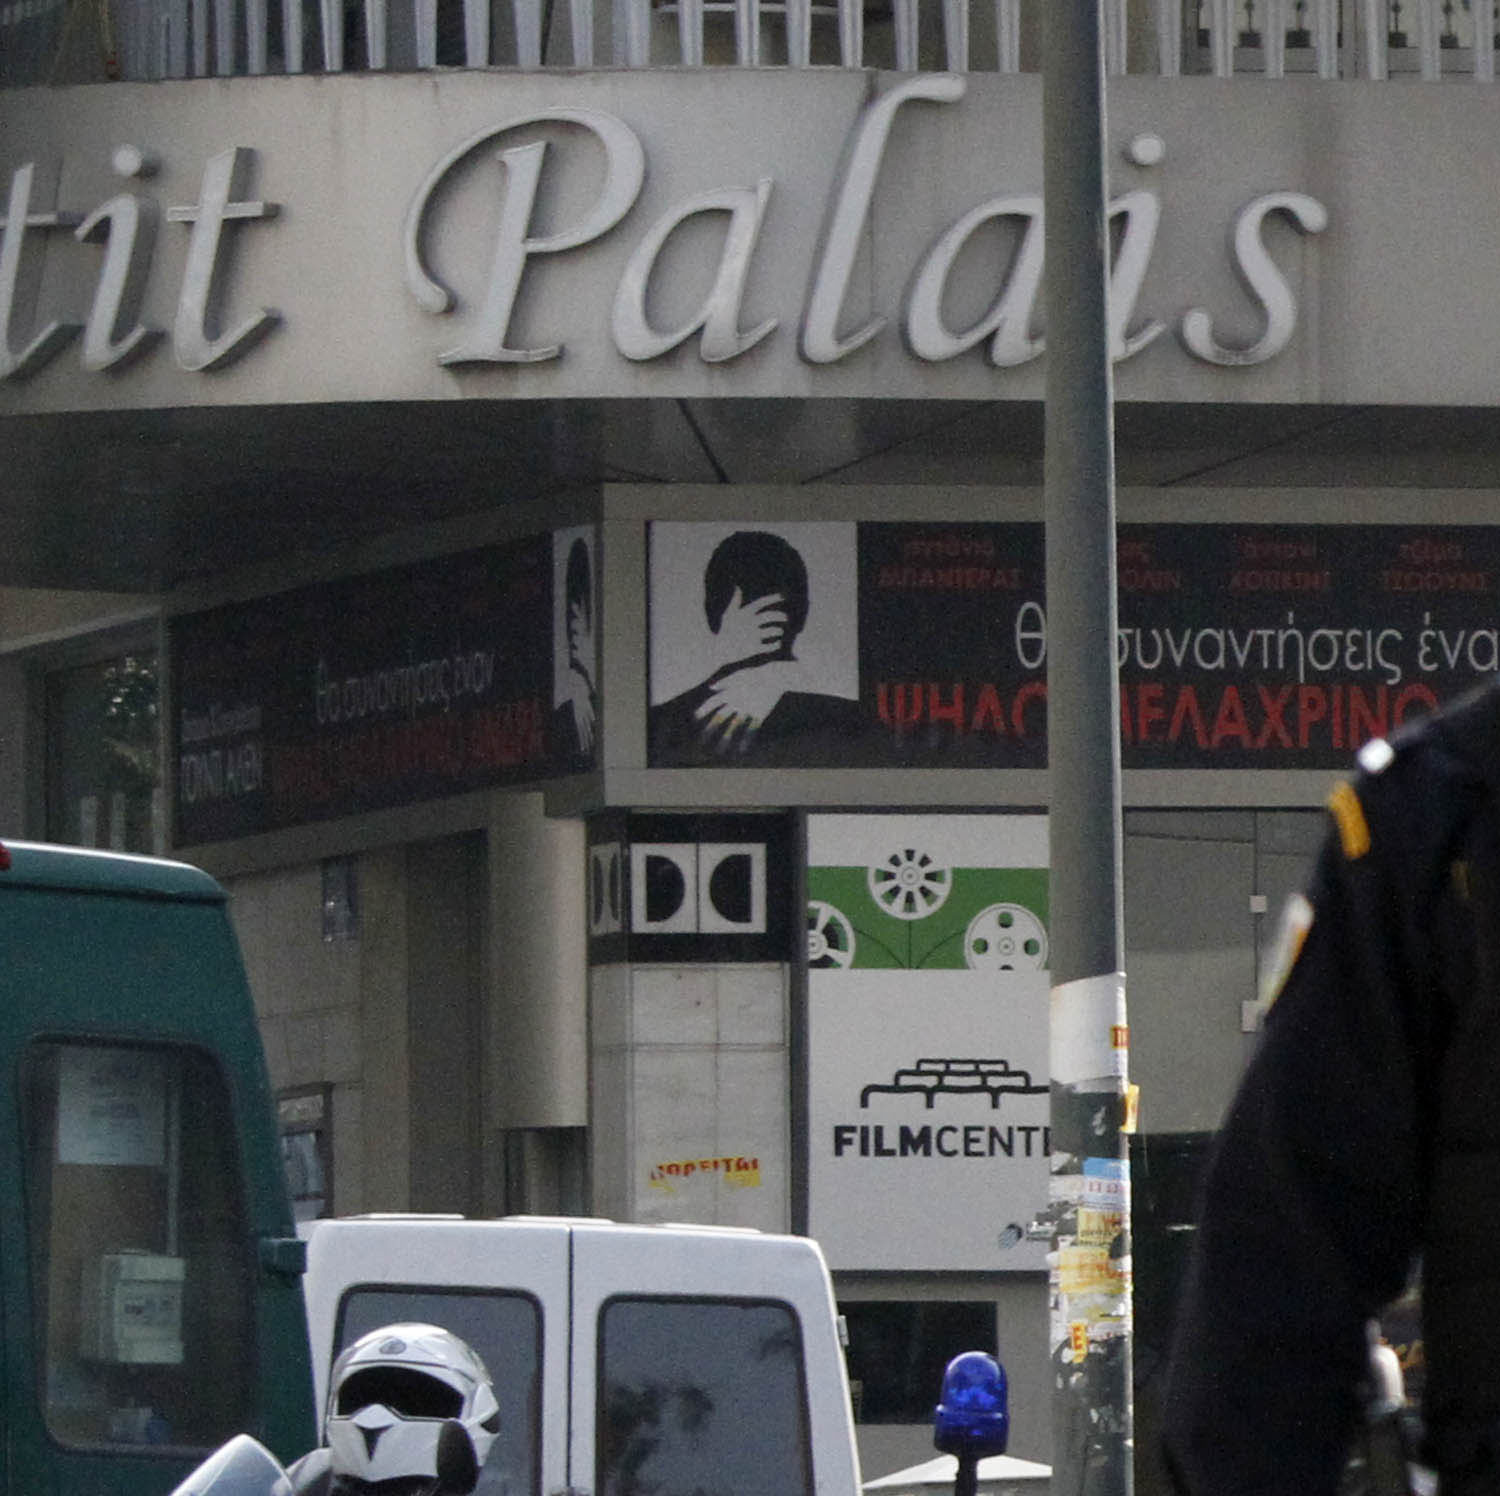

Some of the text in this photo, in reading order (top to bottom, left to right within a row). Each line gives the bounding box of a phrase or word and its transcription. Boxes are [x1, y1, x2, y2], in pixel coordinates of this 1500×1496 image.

[406, 73, 1328, 368] Palais
[1016, 601, 1048, 669] θ
[1117, 611, 1402, 685] συναντήσεις
[1118, 682, 1441, 749] ΕΛΑΧΡΙΝΟ
[833, 1124, 1051, 1157] FILMCENT
